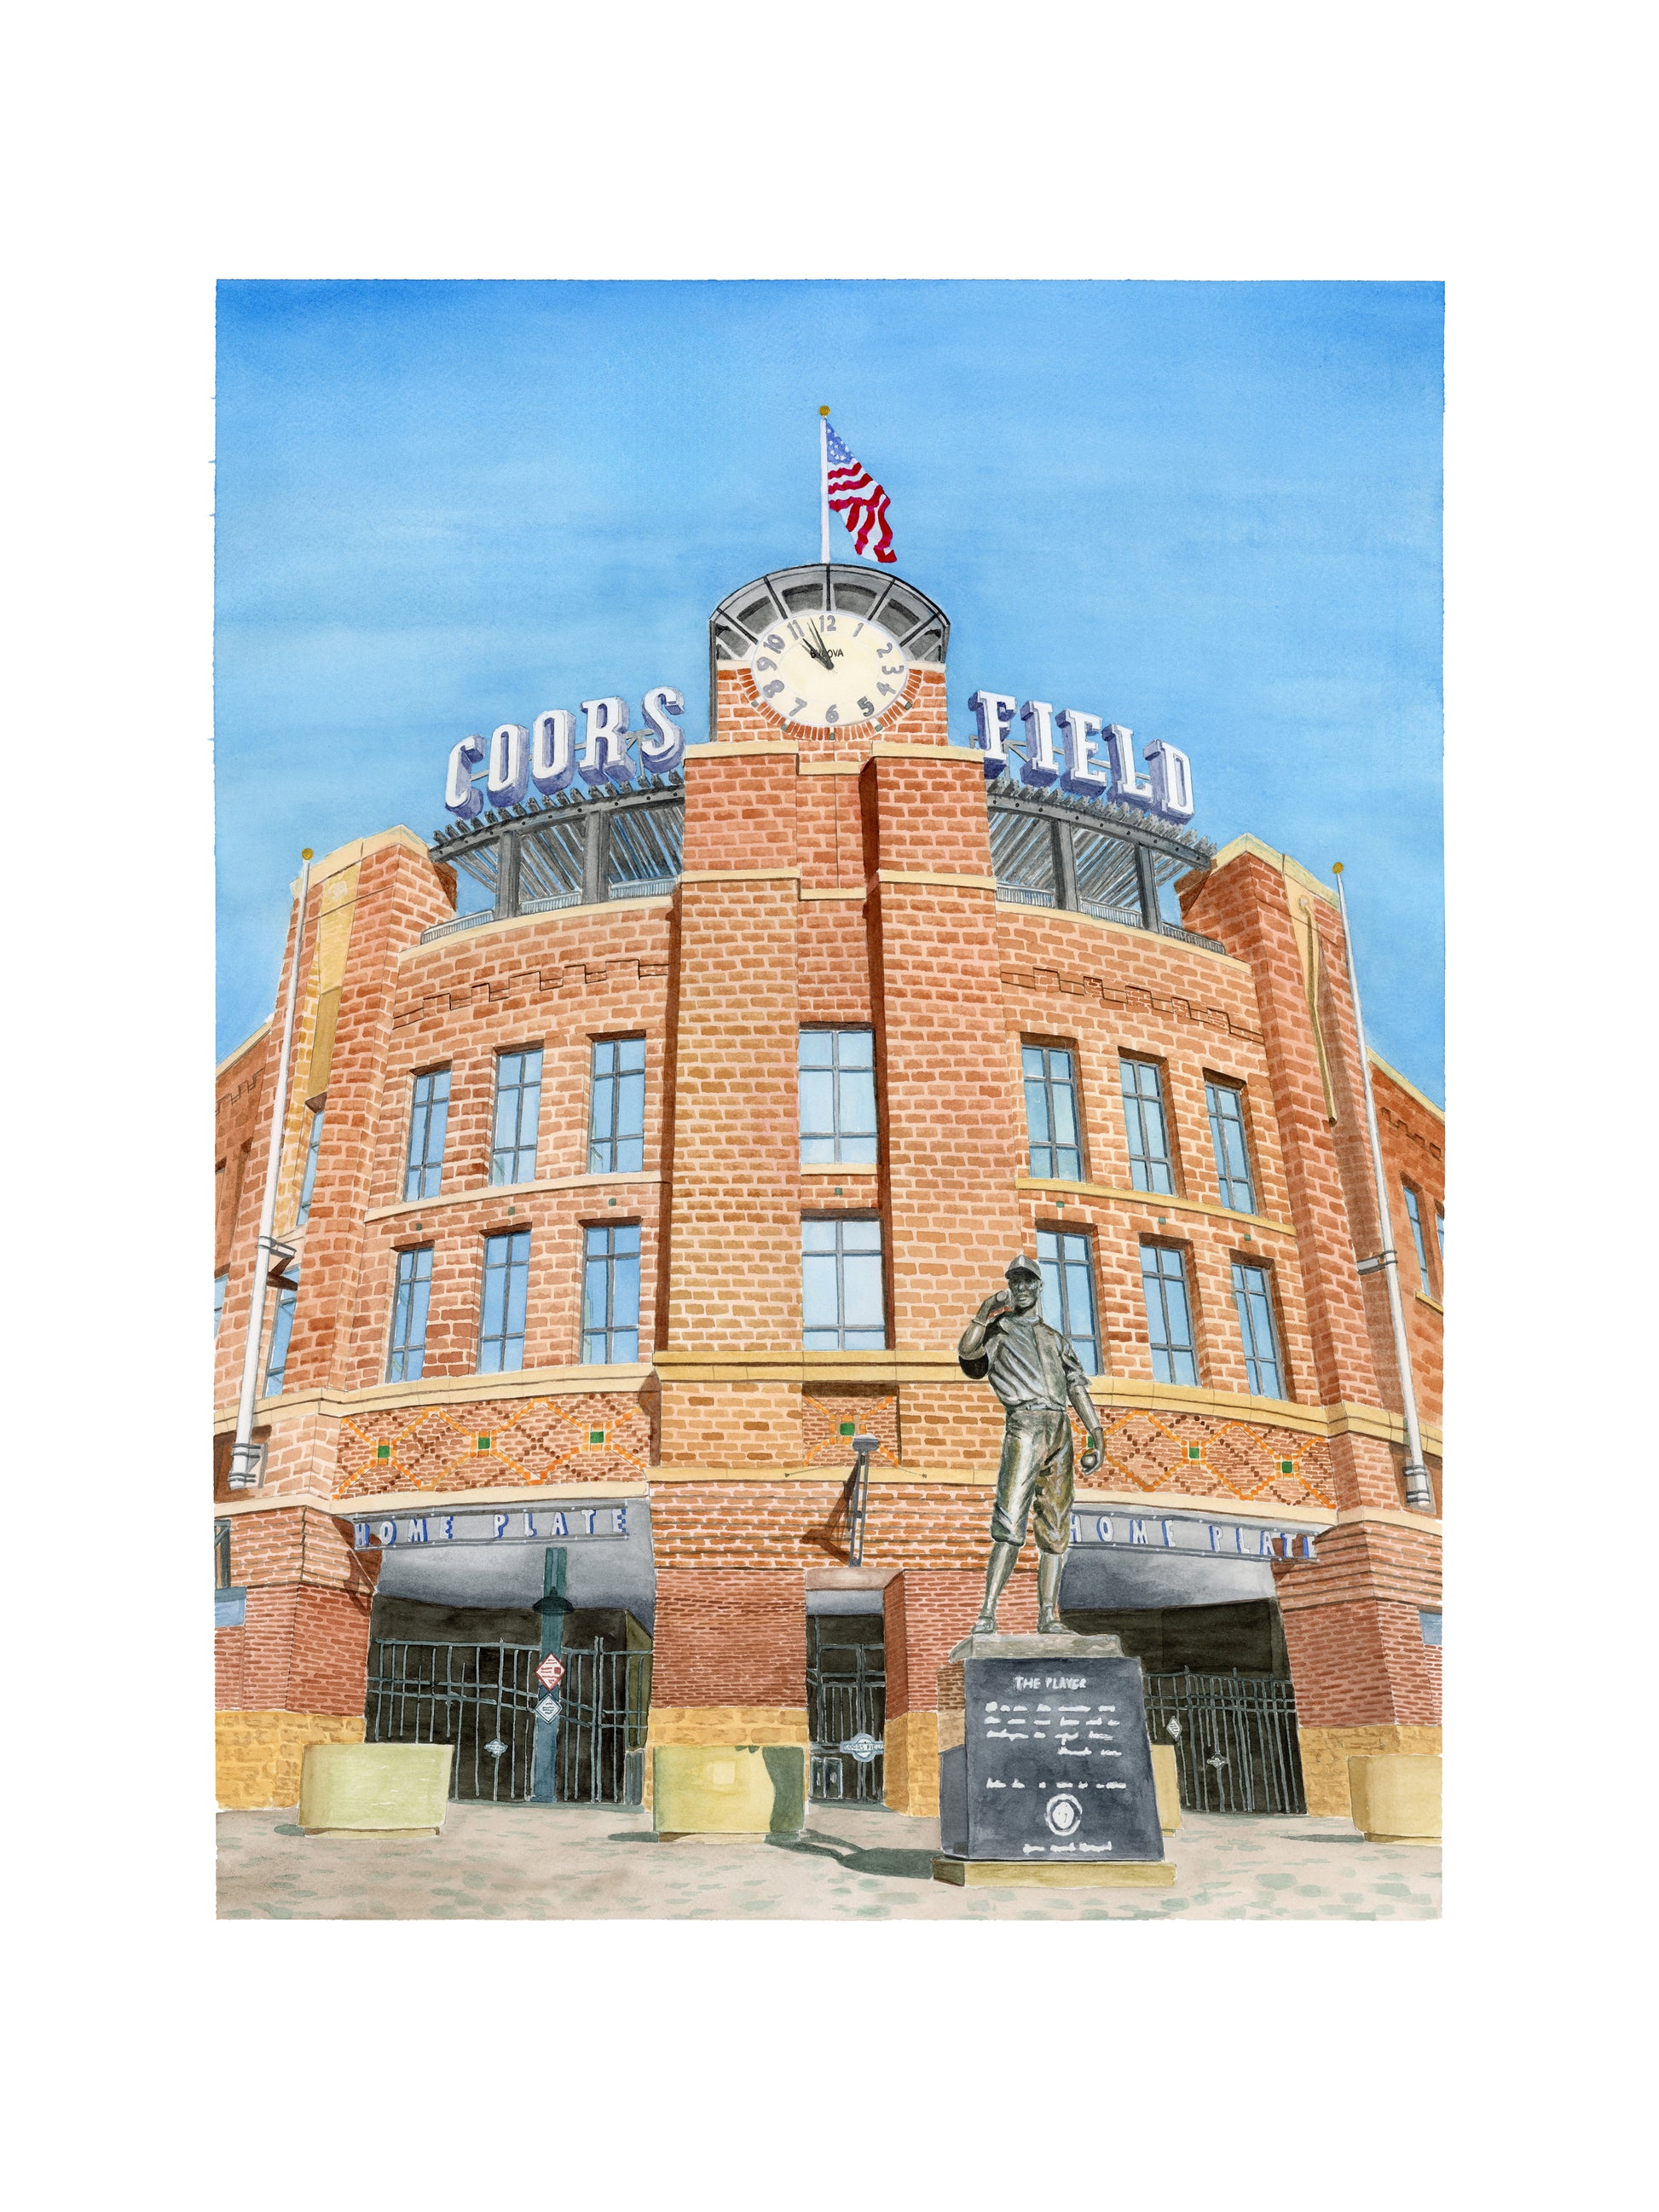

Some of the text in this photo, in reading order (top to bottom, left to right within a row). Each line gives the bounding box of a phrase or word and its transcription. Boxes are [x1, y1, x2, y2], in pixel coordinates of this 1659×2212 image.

[787, 620, 805, 640] 11
[819, 615, 836, 632] 12
[853, 623, 864, 637] 1
[763, 634, 785, 654] 10
[876, 643, 893, 658] 2
[756, 656, 777, 671] 9
[882, 665, 905, 675] 3
[763, 679, 785, 698] 8
[876, 682, 895, 696] 4
[789, 697, 807, 716] 7
[825, 704, 839, 723] 6
[857, 696, 875, 717] 5
[445, 686, 1194, 825] COORS FIELD
[355, 1509, 627, 1546] HOME PLATE
[1069, 1514, 1317, 1558] HOME PLATE
[1014, 1676, 1087, 1690] THE PLAYER
